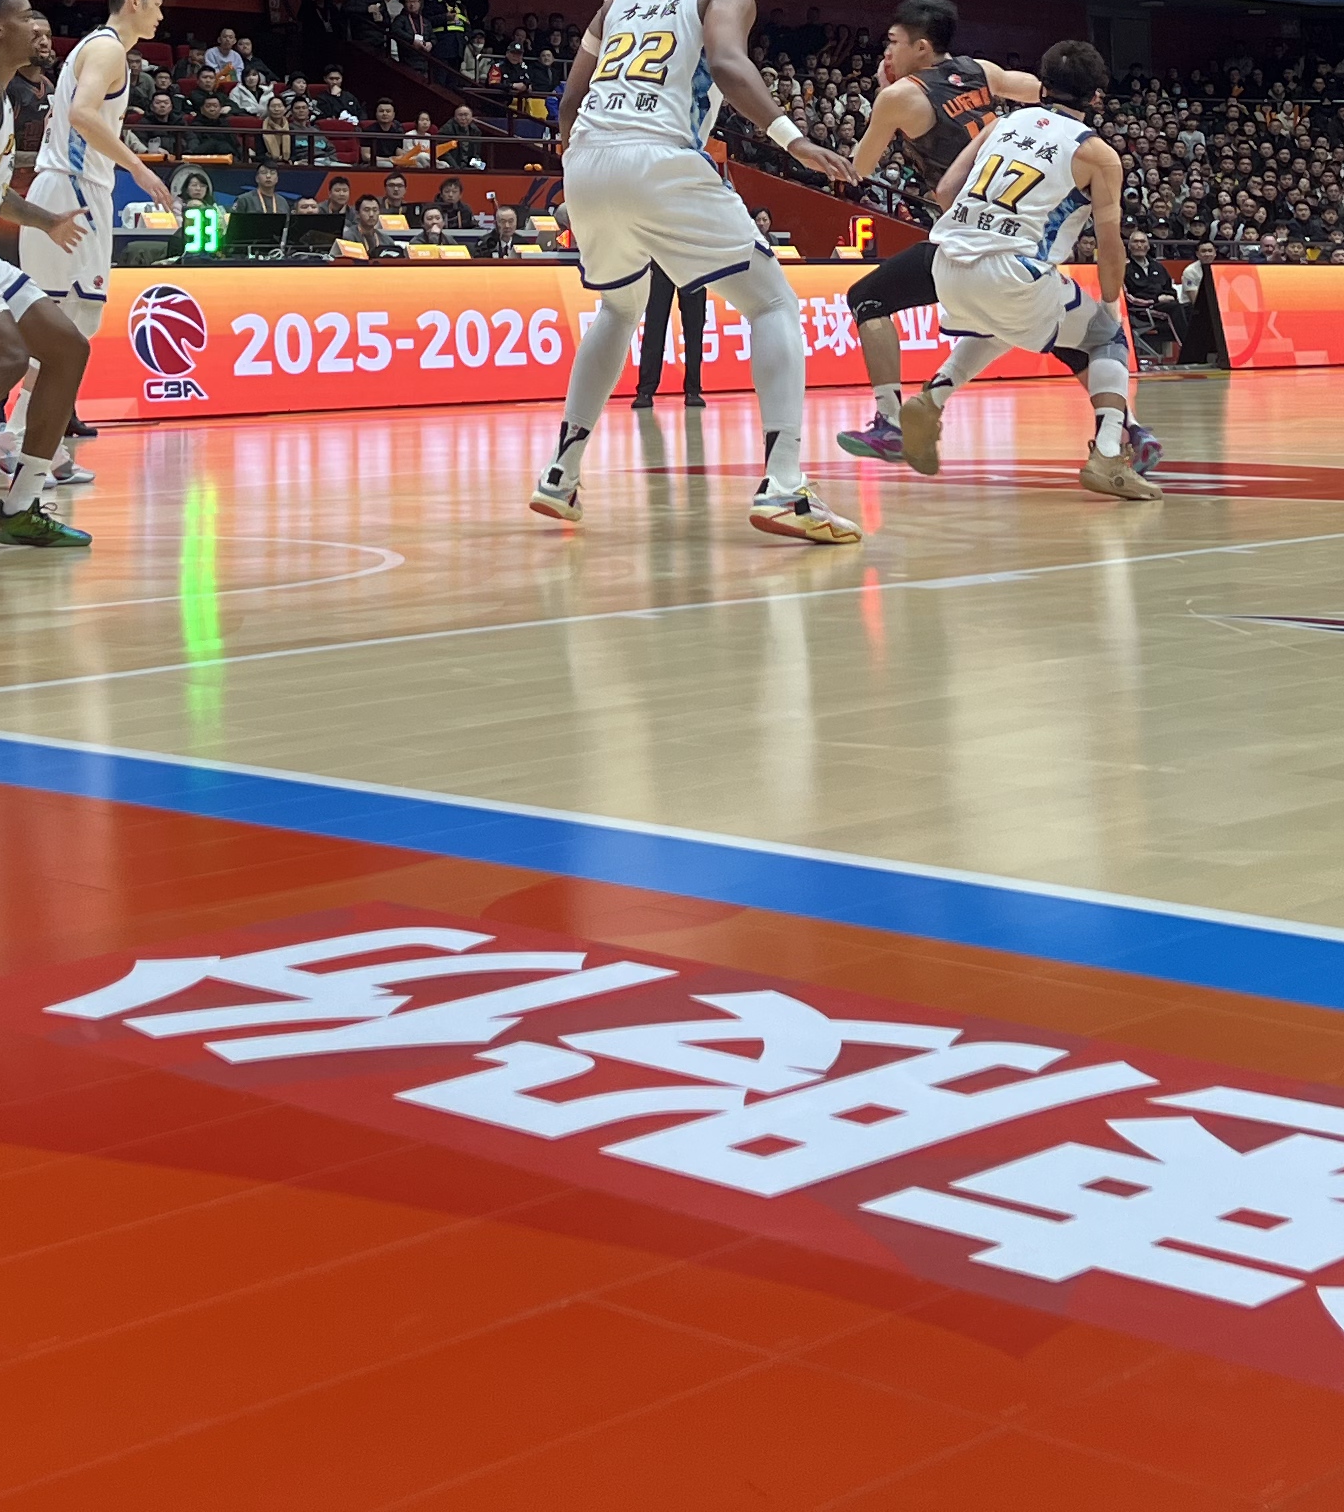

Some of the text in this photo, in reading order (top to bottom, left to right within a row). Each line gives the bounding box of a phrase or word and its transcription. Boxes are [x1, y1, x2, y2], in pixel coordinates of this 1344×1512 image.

[592, 29, 678, 86] 22
[967, 153, 1046, 215] 17
[184, 206, 219, 253] 33
[232, 308, 563, 379] 2025-2026
[143, 376, 209, 402] CBA
